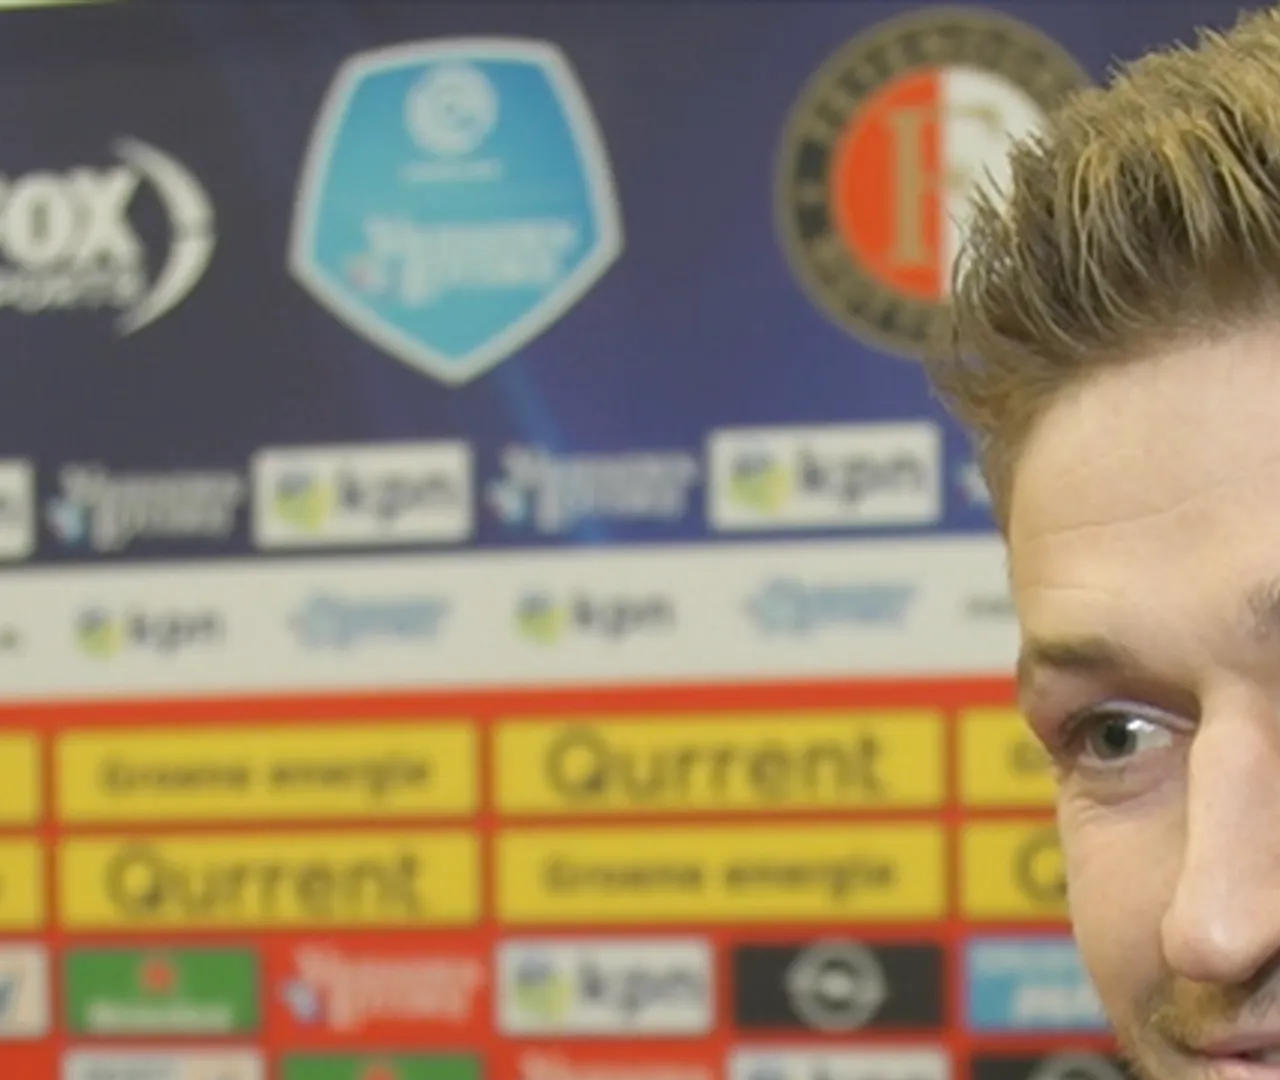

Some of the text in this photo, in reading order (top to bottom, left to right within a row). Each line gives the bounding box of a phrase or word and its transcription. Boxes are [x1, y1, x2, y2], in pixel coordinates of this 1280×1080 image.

[333, 462, 462, 521] kpn
[793, 446, 926, 503] kpn
[569, 591, 678, 642] kpn
[100, 757, 431, 799] Groene energie
[544, 727, 888, 800] Qurrent
[105, 842, 423, 917] Qurrent
[542, 858, 896, 902] Groene energie
[576, 956, 710, 1012] kpn
